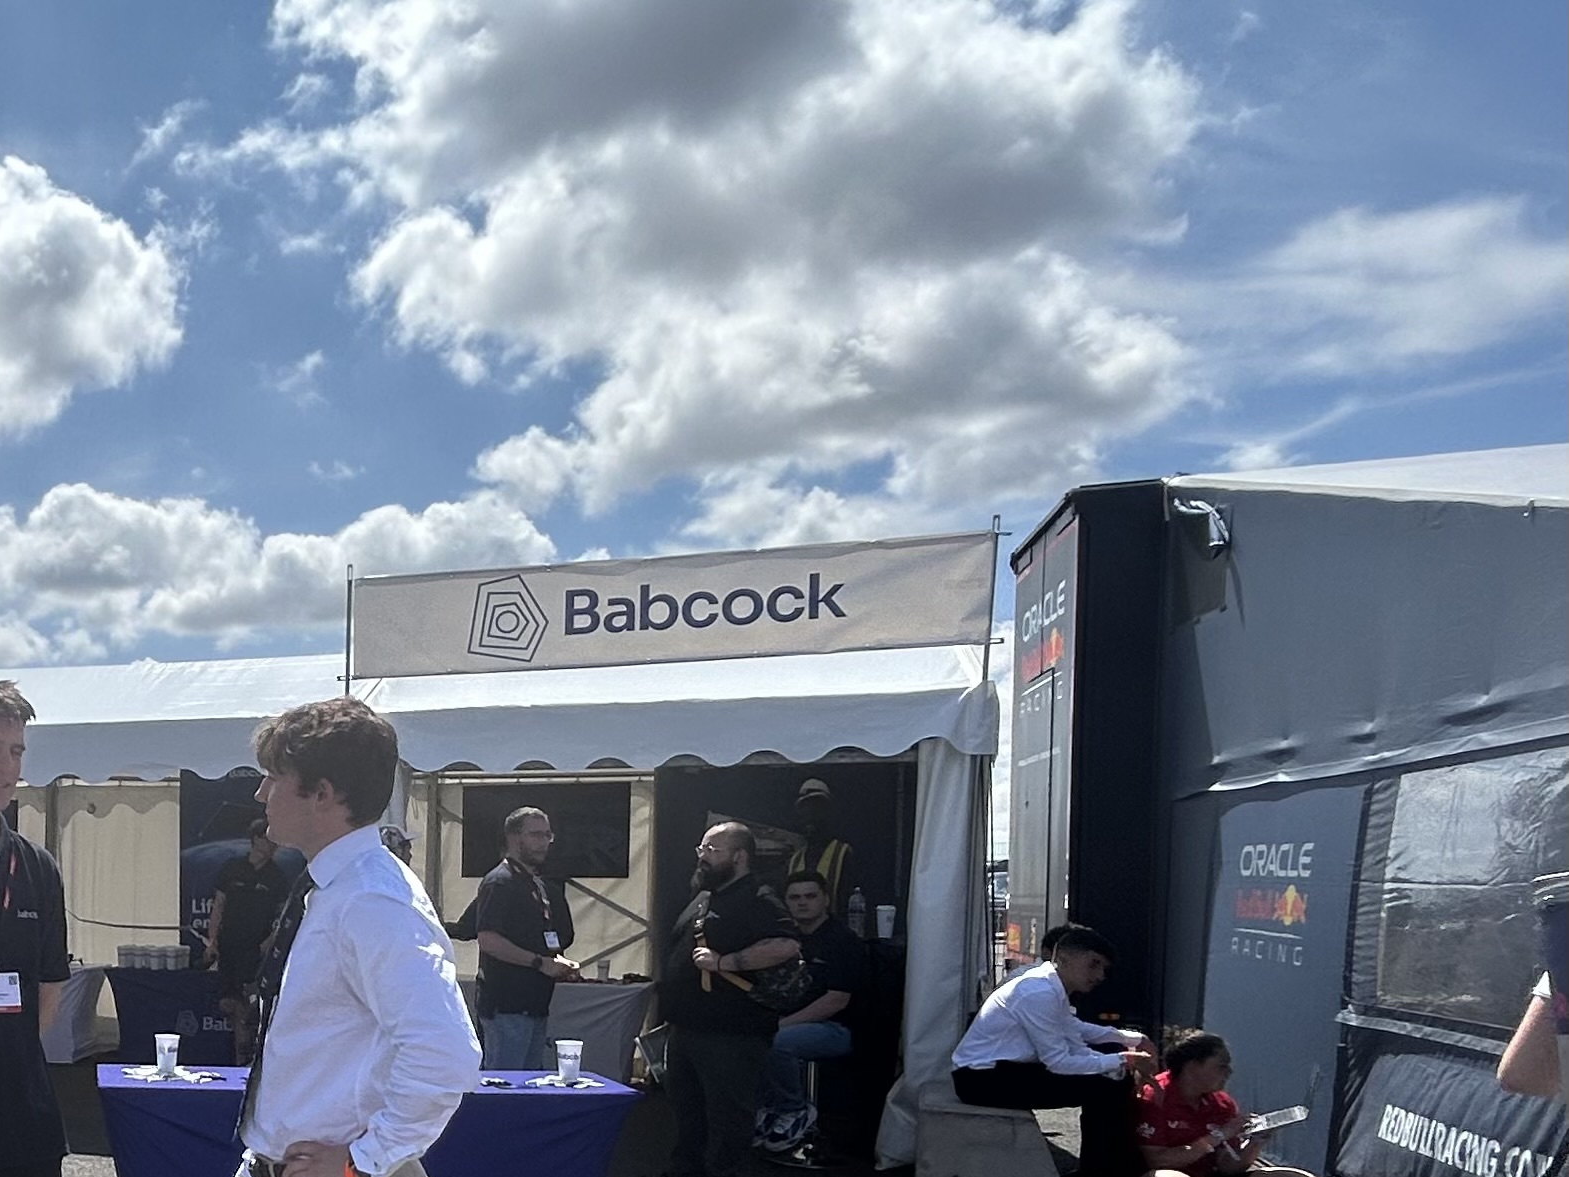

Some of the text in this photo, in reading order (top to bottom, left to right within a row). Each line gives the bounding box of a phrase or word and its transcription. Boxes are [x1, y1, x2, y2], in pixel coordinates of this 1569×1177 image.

[564, 572, 848, 636] Babcock
[1021, 578, 1067, 643] ORACLE
[1240, 842, 1315, 878] ORACLE
[1231, 937, 1303, 966] RACING
